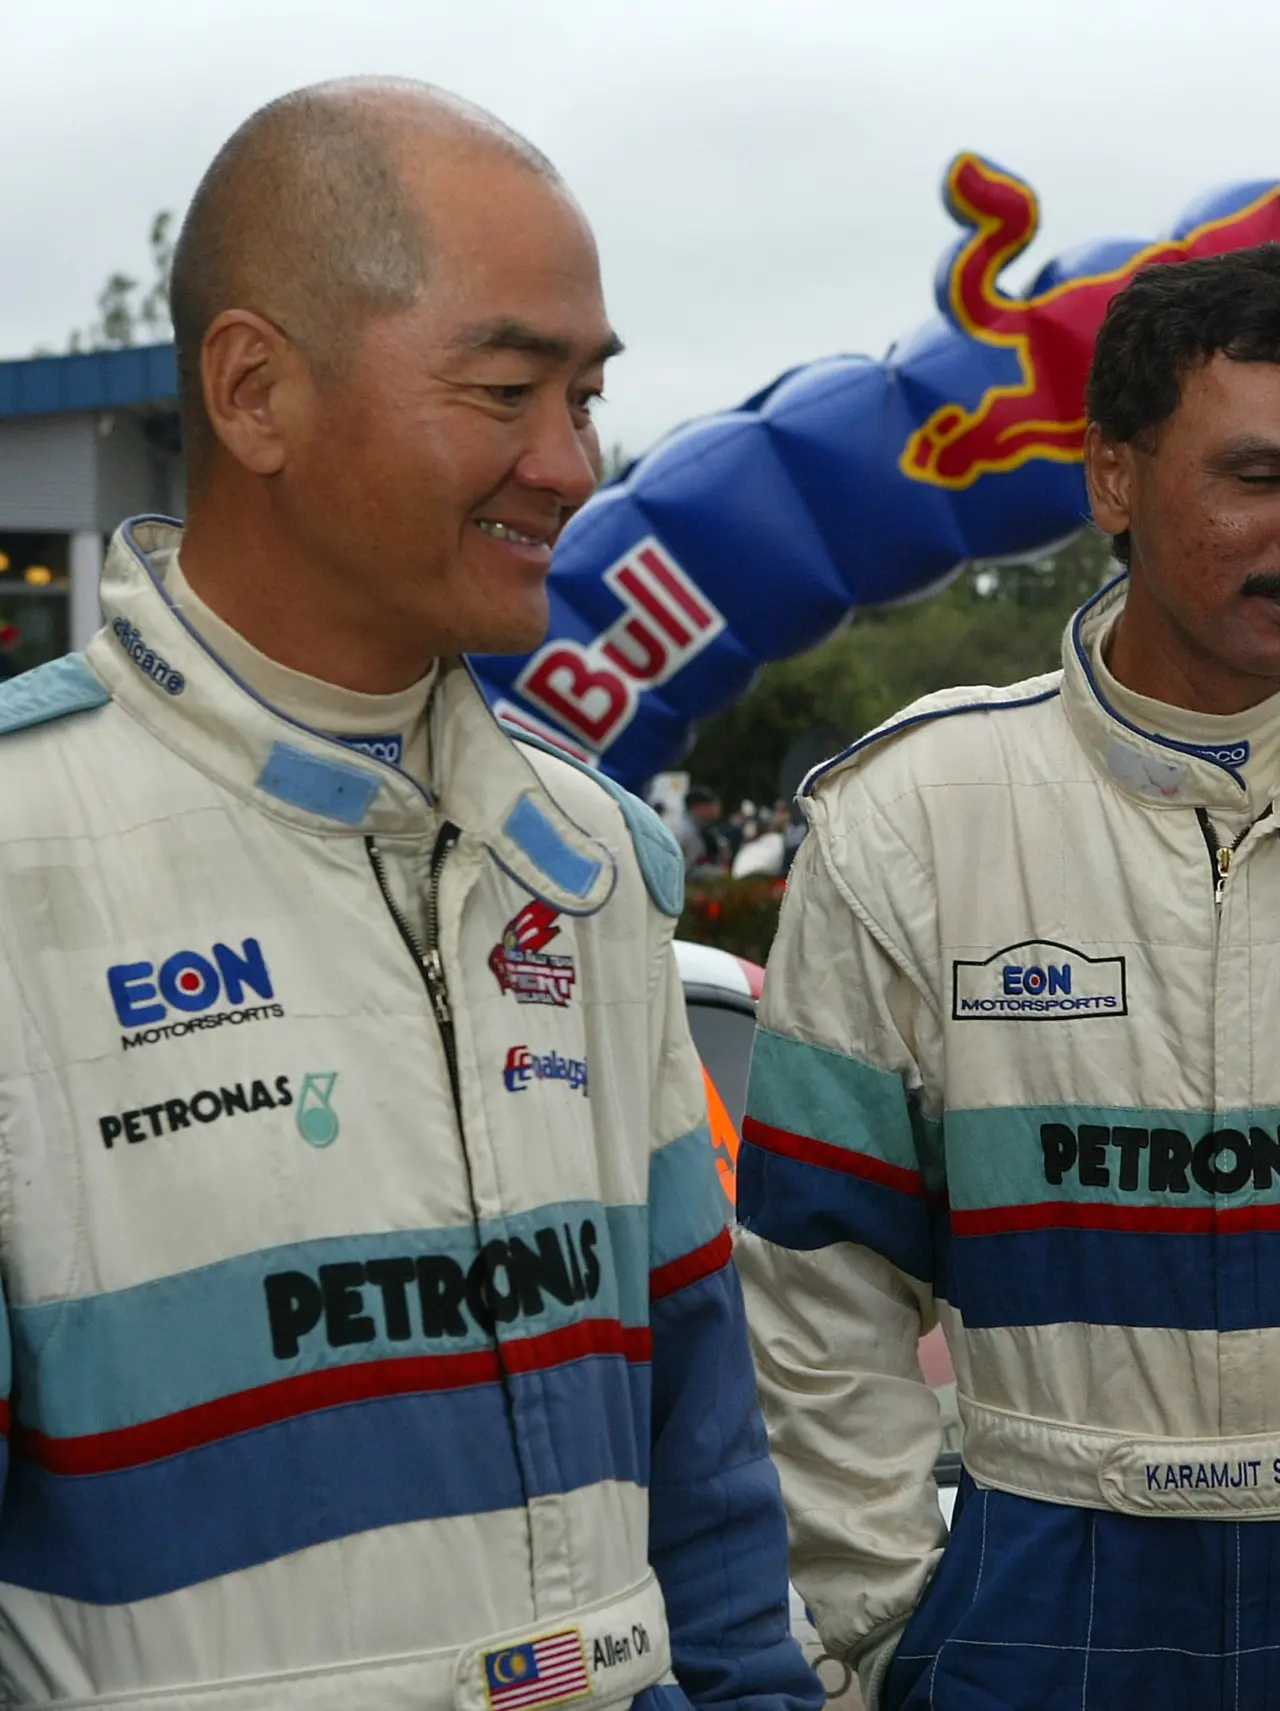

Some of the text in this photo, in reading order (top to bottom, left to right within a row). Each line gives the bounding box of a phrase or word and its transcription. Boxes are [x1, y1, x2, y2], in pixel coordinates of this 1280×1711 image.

[512, 534, 727, 756] Bull
[107, 937, 274, 1028] EON
[1002, 964, 1072, 996] EON
[961, 996, 1117, 1011] MOTORSPORTS
[121, 1003, 285, 1050] MOTORSPORTS
[99, 1075, 293, 1149] PETRONAS
[1145, 1460, 1261, 1490] KARAMJIT
[594, 1634, 632, 1672] Allen
